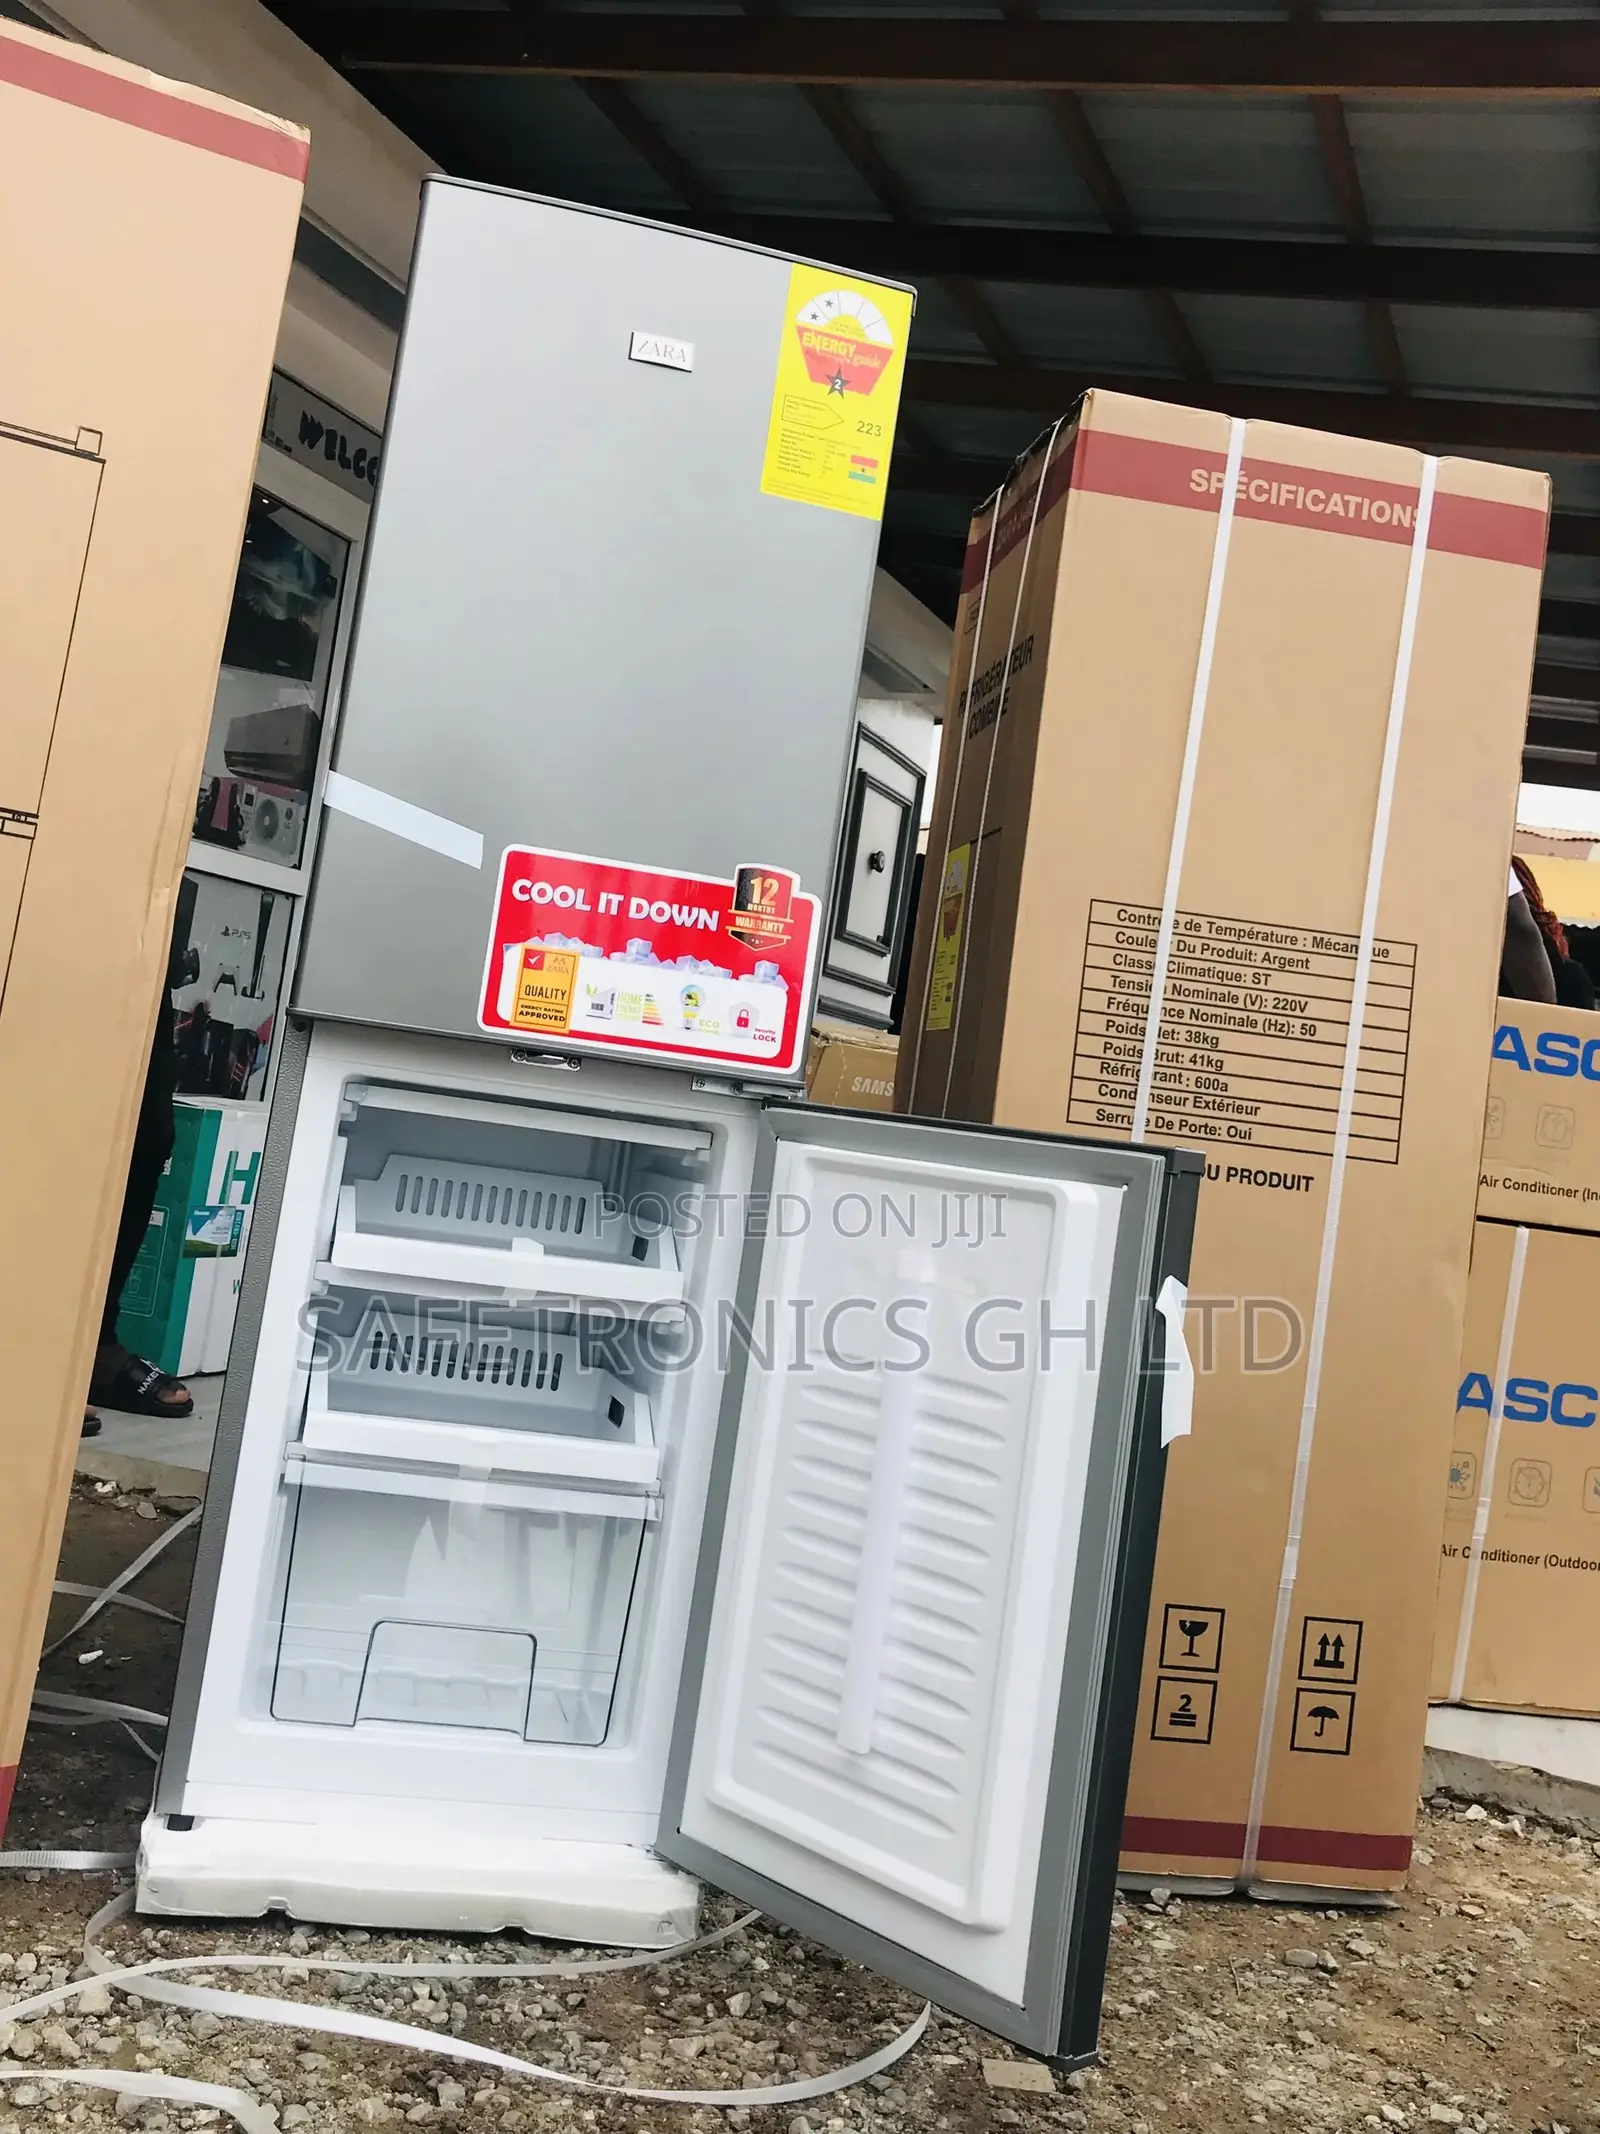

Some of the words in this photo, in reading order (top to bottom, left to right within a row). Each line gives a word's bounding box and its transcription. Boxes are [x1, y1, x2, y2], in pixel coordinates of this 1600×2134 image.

[638, 340, 686, 362] ZARA
[802, 330, 857, 358] ENERGY
[852, 354, 882, 368] guide
[833, 379, 842, 389] 2
[857, 421, 882, 437] 223
[511, 878, 591, 912] COOL
[598, 891, 625, 916] IT
[628, 897, 720, 932] DOWN
[750, 876, 780, 905] 12
[747, 903, 776, 914] MONTHS
[231, 929, 251, 940] PS5
[735, 915, 785, 933] WARRANTY
[1184, 918, 1202, 933] de
[1206, 920, 1299, 946] Température
[1312, 935, 1390, 959] Mécanue
[1177, 939, 1196, 954] Du
[1200, 942, 1258, 962] Produit:
[1261, 951, 1311, 969] Argent
[1167, 960, 1247, 982] Climatique:
[1251, 971, 1272, 986] ST
[524, 984, 567, 1001] QUALITY
[1171, 982, 1240, 1005] Nominale
[1243, 992, 1268, 1010] (V):
[1272, 996, 1309, 1013] 220V
[518, 1010, 566, 1022] APPROVED
[1106, 996, 1185, 1019] Fréqunce
[1189, 1007, 1258, 1028] Nominale
[1262, 1017, 1295, 1037] (Hz):
[1299, 1023, 1317, 1037] 50
[753, 1034, 777, 1044] LOCK
[1105, 1019, 1147, 1037] Poids
[1184, 1030, 1220, 1048] 38kg
[1103, 1041, 1144, 1058] Poids
[1189, 1053, 1224, 1071] 41kg
[1100, 1061, 1184, 1085] Réfrigrant
[1194, 1076, 1229, 1092] 600a
[1098, 1083, 1190, 1107] Condnseur
[1192, 1095, 1261, 1116] Extérieur
[1095, 1108, 1150, 1128] Serrue
[1154, 1116, 1175, 1130] De
[1178, 1119, 1222, 1137] Porte:
[1226, 1125, 1253, 1141] Oui
[218, 1151, 262, 1205] H
[1202, 1163, 1220, 1181] U
[1226, 1166, 1315, 1192] PRODUIT
[1480, 1174, 1500, 1188] Air
[1502, 1177, 1580, 1199] Conditioner
[1582, 1187, 1600, 1203] (In
[1461, 1546, 1541, 1565] Cnditioner
